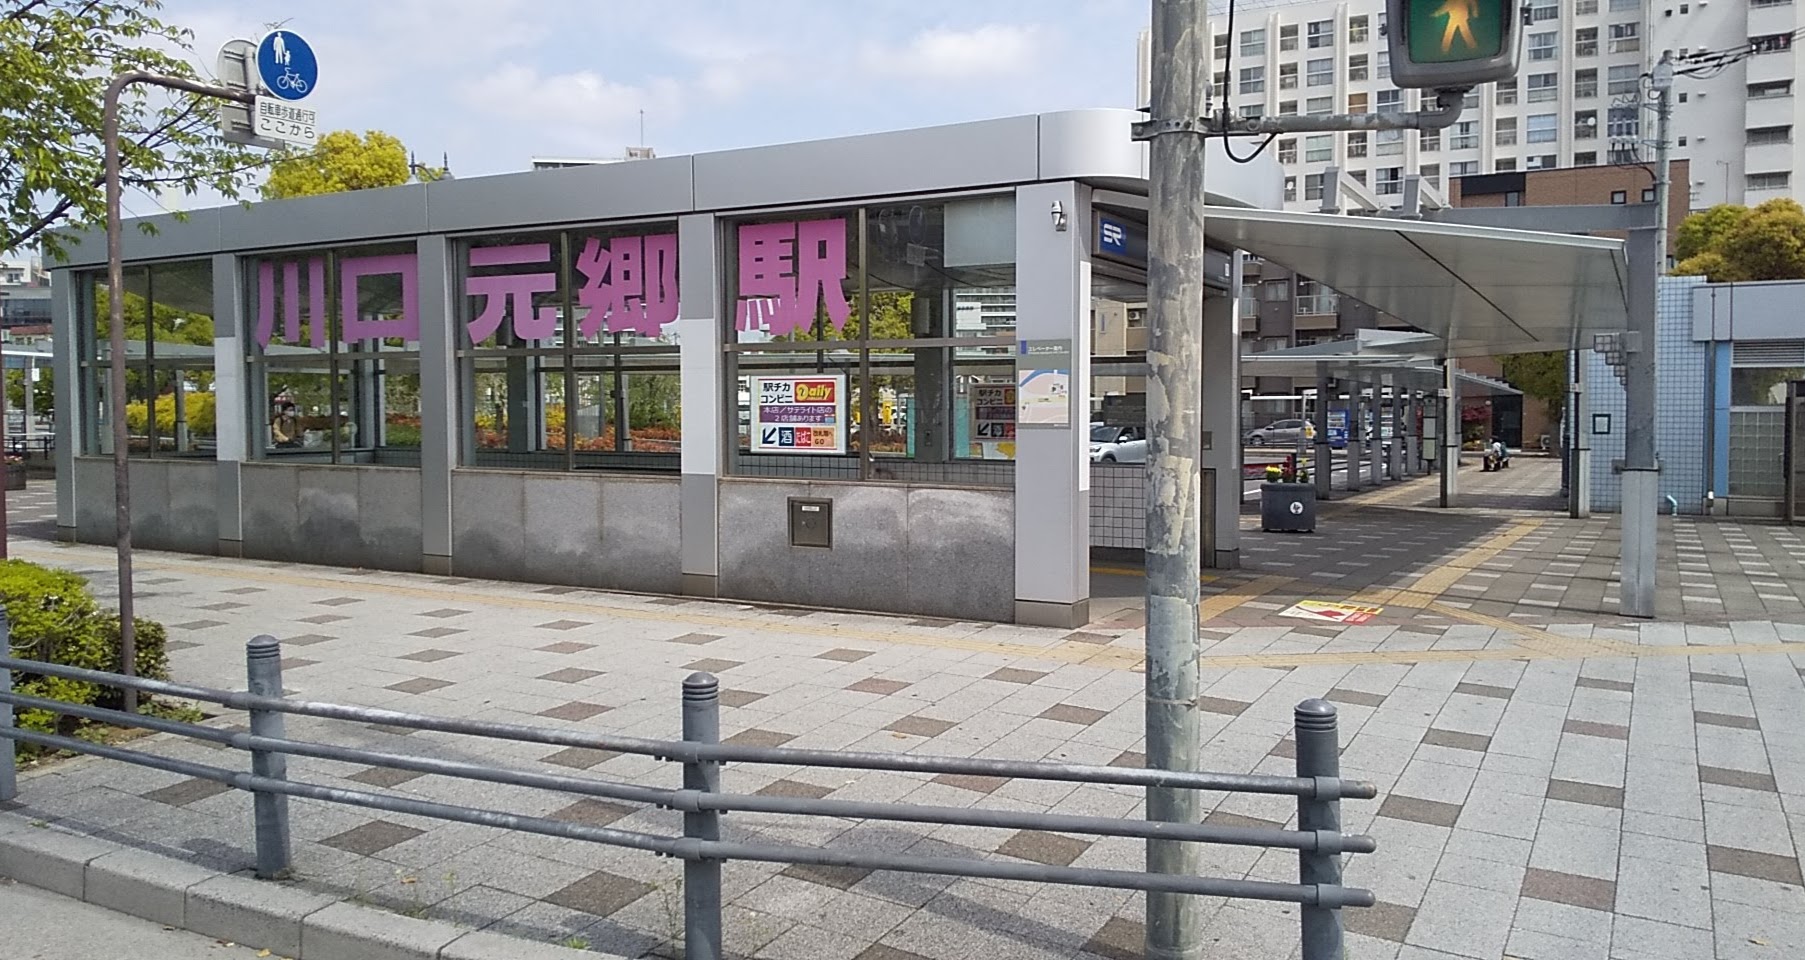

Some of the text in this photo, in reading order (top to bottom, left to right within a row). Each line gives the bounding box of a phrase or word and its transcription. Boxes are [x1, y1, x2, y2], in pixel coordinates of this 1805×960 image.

[260, 118, 315, 139] ここから
[1103, 223, 1122, 246] SR
[256, 218, 850, 350] 川口元郷駅
[763, 382, 791, 392] 駅チカ
[795, 383, 832, 401] Daily
[760, 394, 793, 404] コンビニ
[780, 430, 793, 444] 酒
